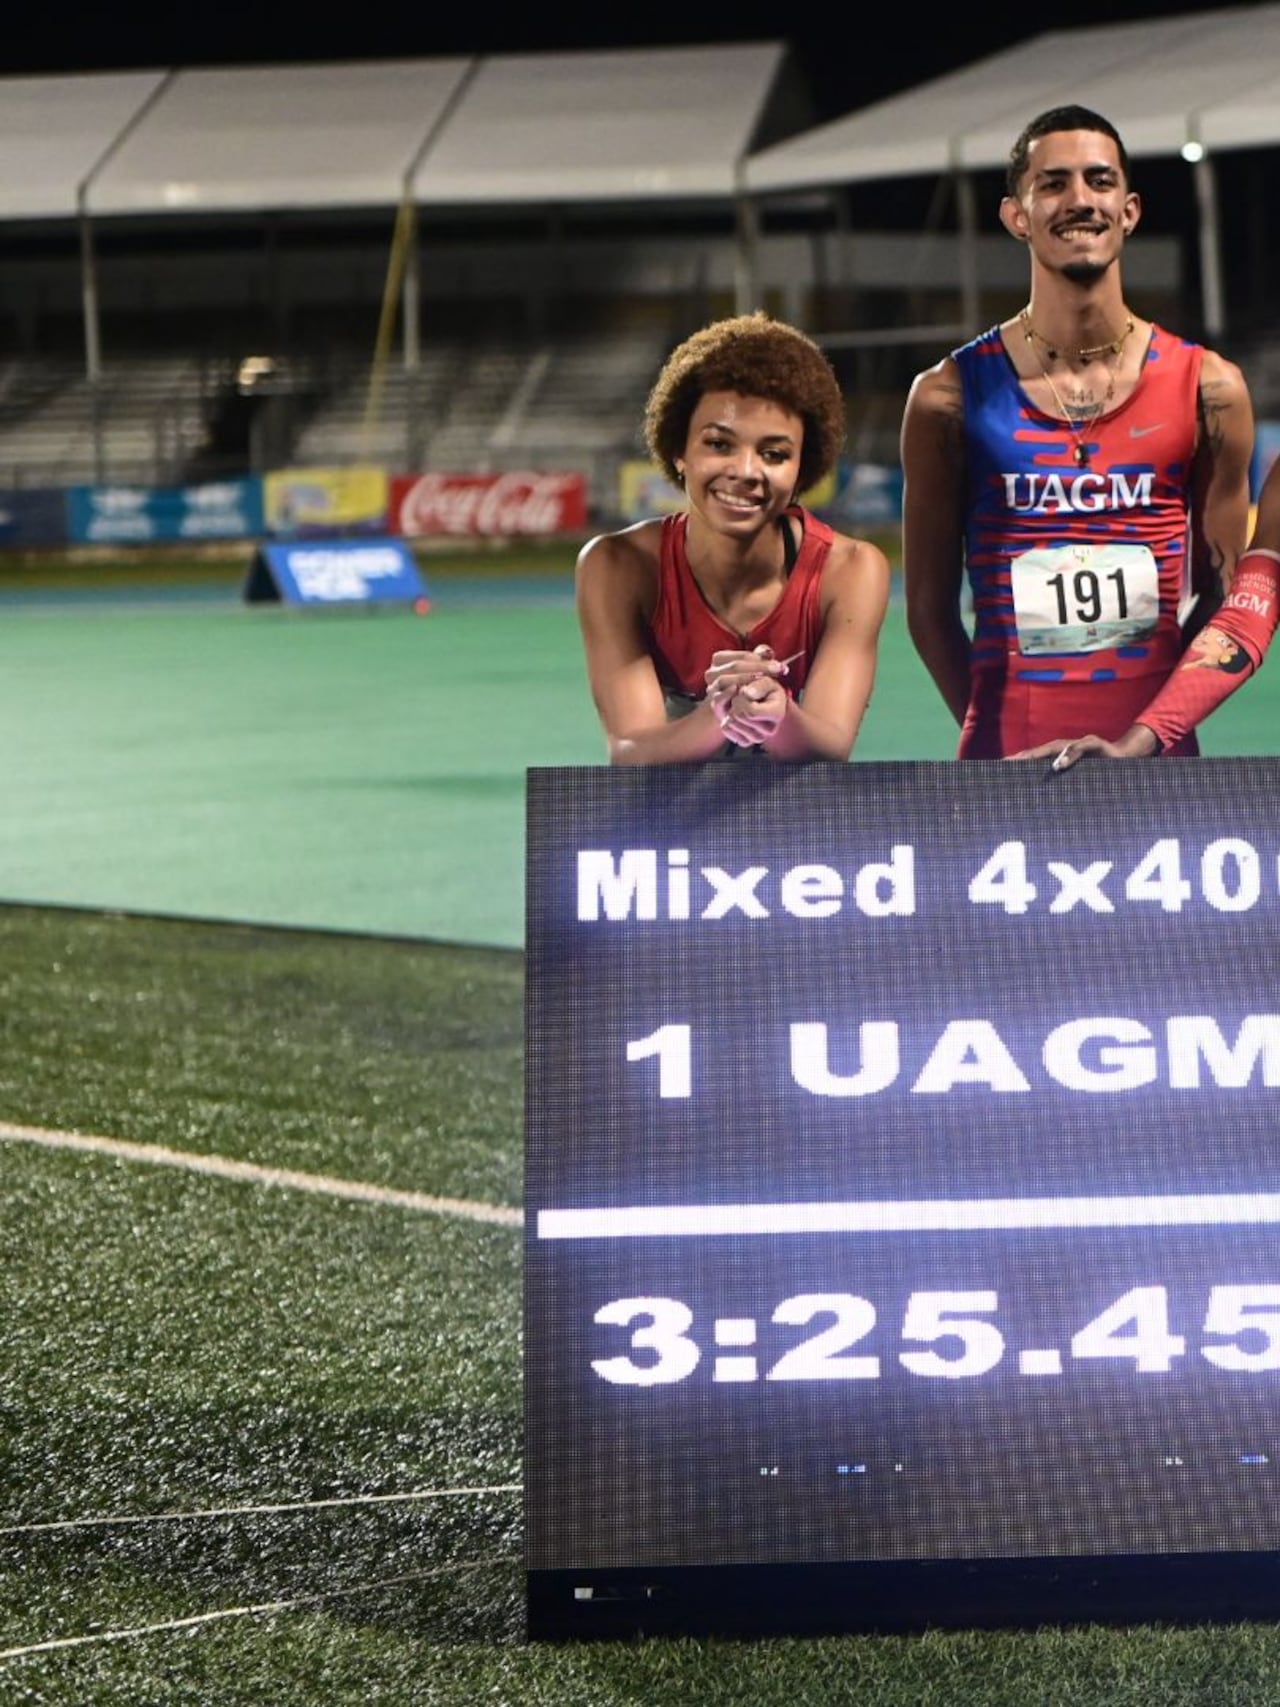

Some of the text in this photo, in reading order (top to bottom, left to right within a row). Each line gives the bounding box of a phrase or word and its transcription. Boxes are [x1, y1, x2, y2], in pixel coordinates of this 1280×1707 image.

[1002, 473, 1156, 512] UAGM
[1046, 567, 1128, 625] 191
[577, 845, 916, 921] Mixed
[626, 1024, 691, 1098] 1
